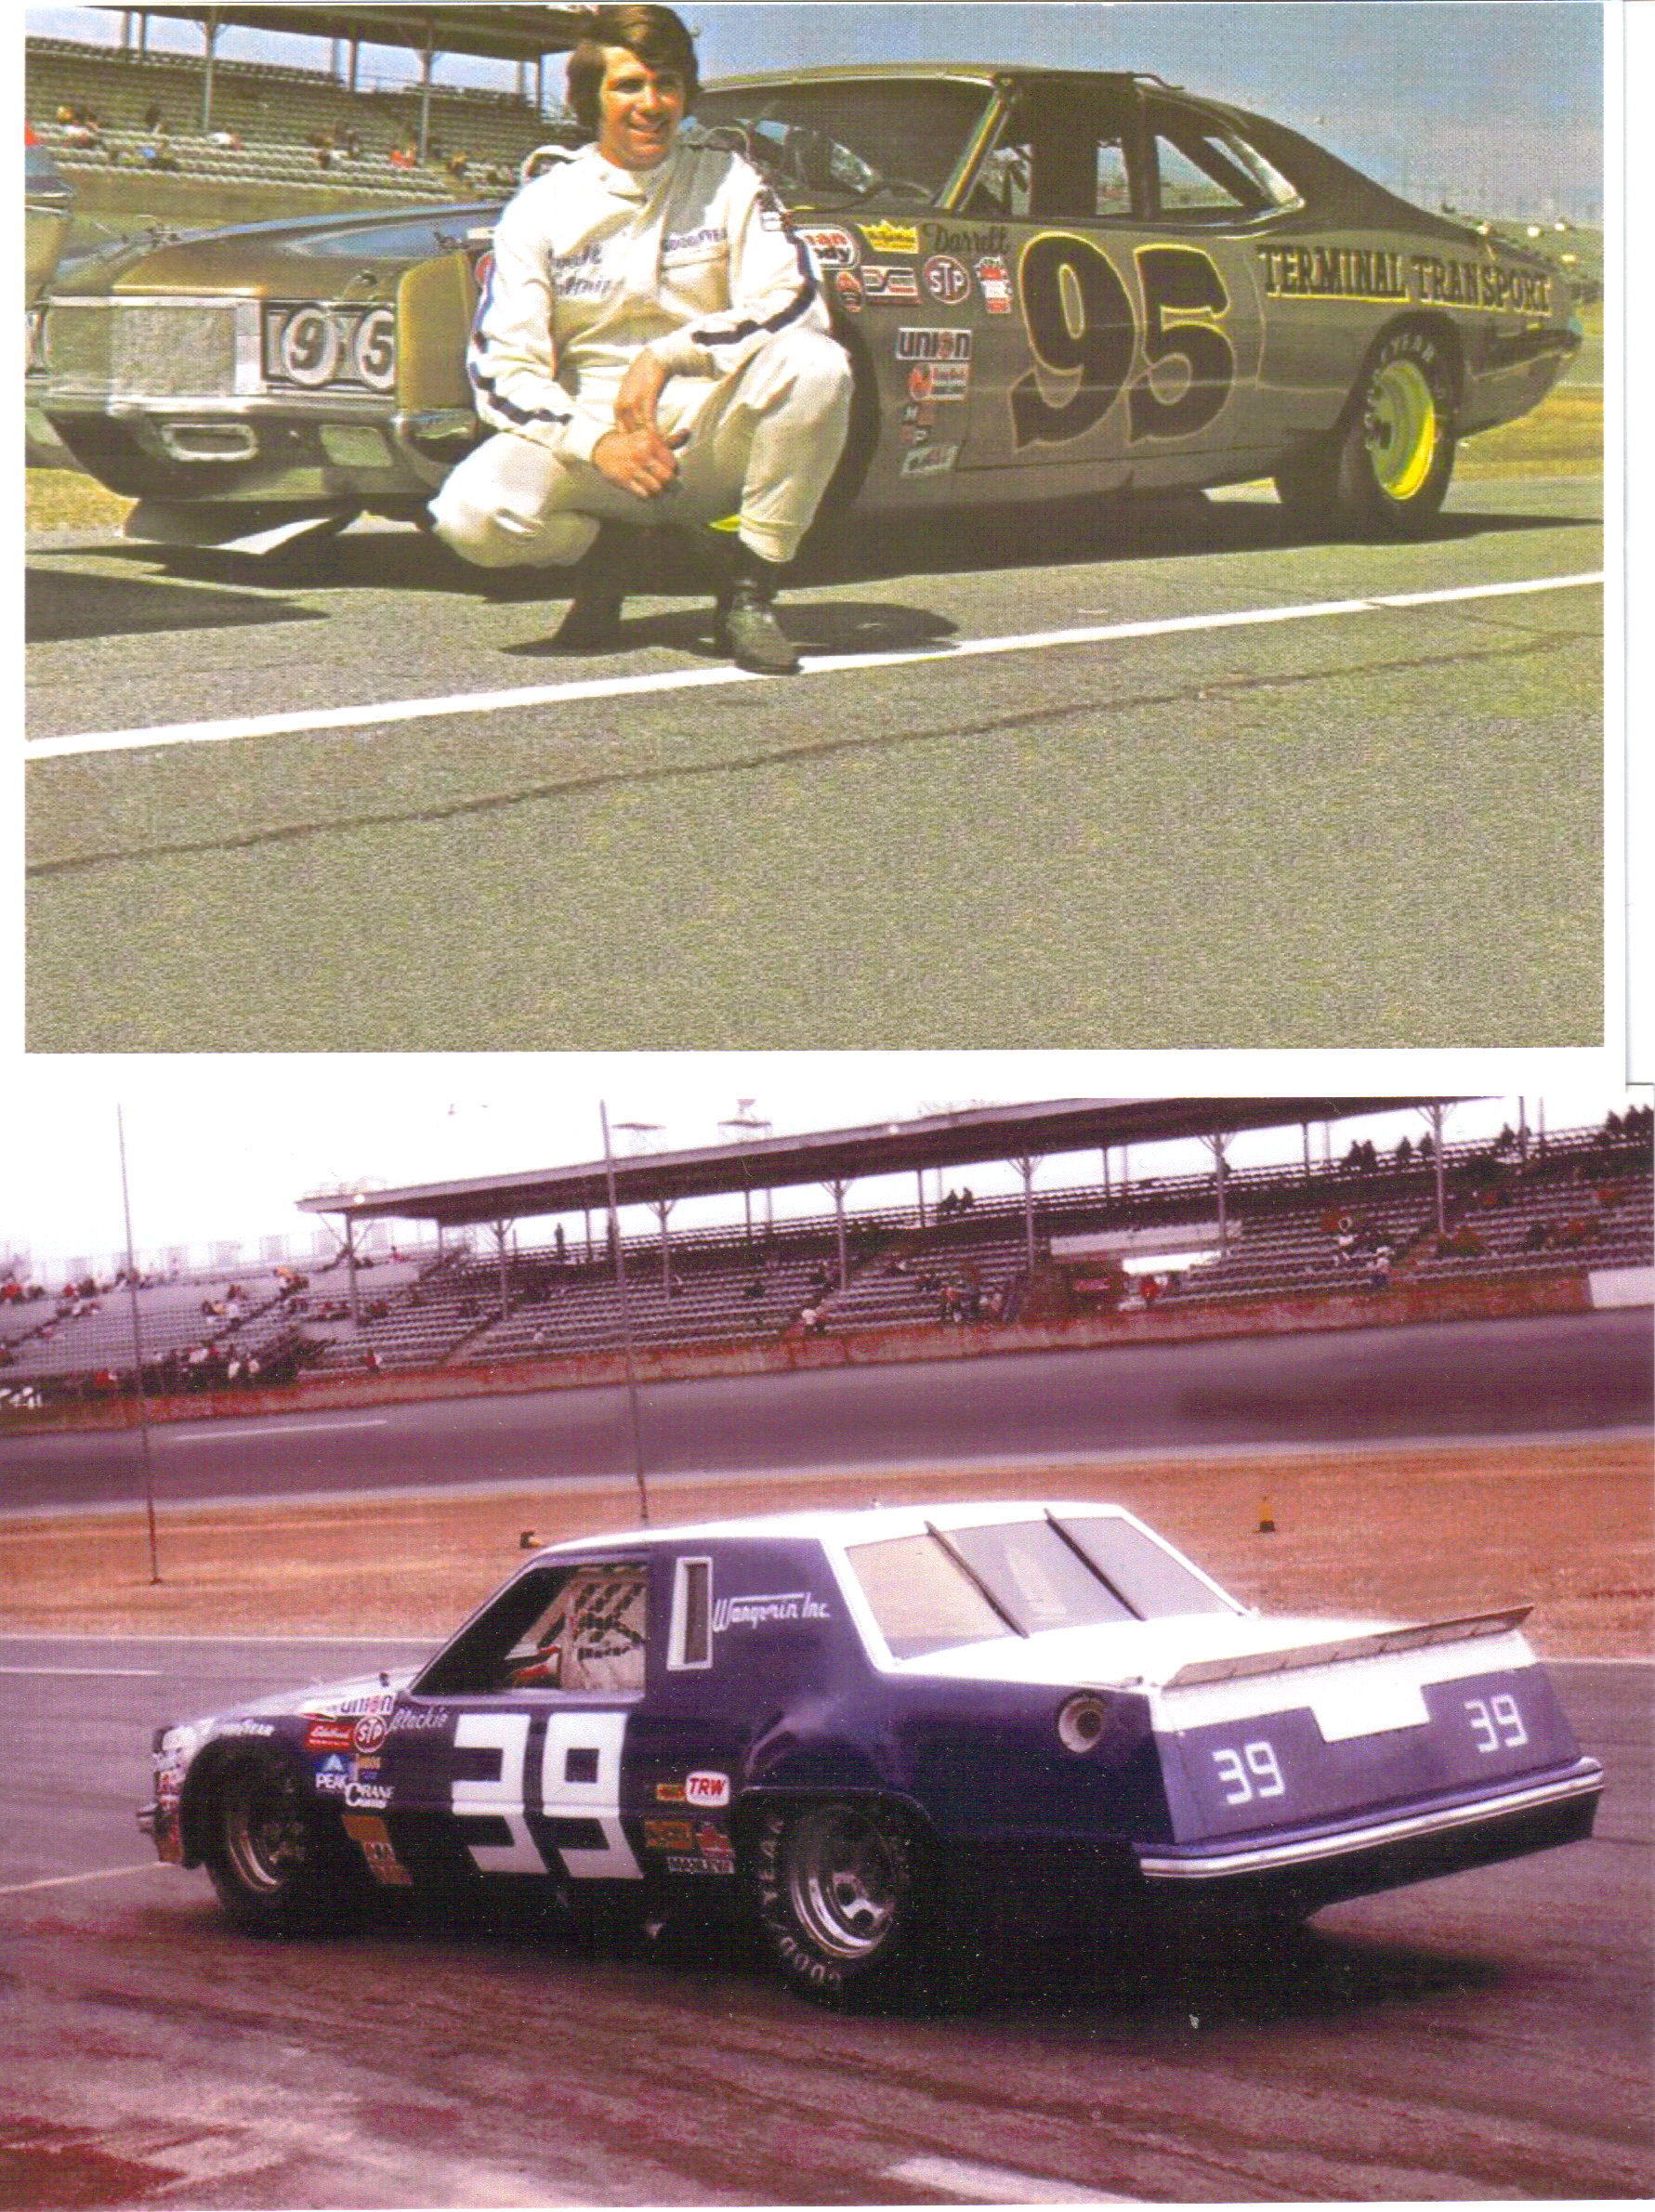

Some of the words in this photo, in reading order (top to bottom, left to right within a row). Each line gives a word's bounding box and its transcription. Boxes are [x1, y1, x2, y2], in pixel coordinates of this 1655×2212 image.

[922, 224, 1011, 253] Darrell
[929, 263, 965, 297] STP
[1255, 243, 1411, 301] TERMINAL
[1412, 254, 1553, 316] TRANSPORT
[291, 315, 395, 376] 95
[1008, 230, 1238, 453] 95
[357, 1717, 384, 1744] STP
[1464, 1693, 1529, 1754] 39
[451, 1711, 641, 1879] 39
[689, 1776, 727, 1797] TRW
[1212, 1740, 1285, 1806] 39
